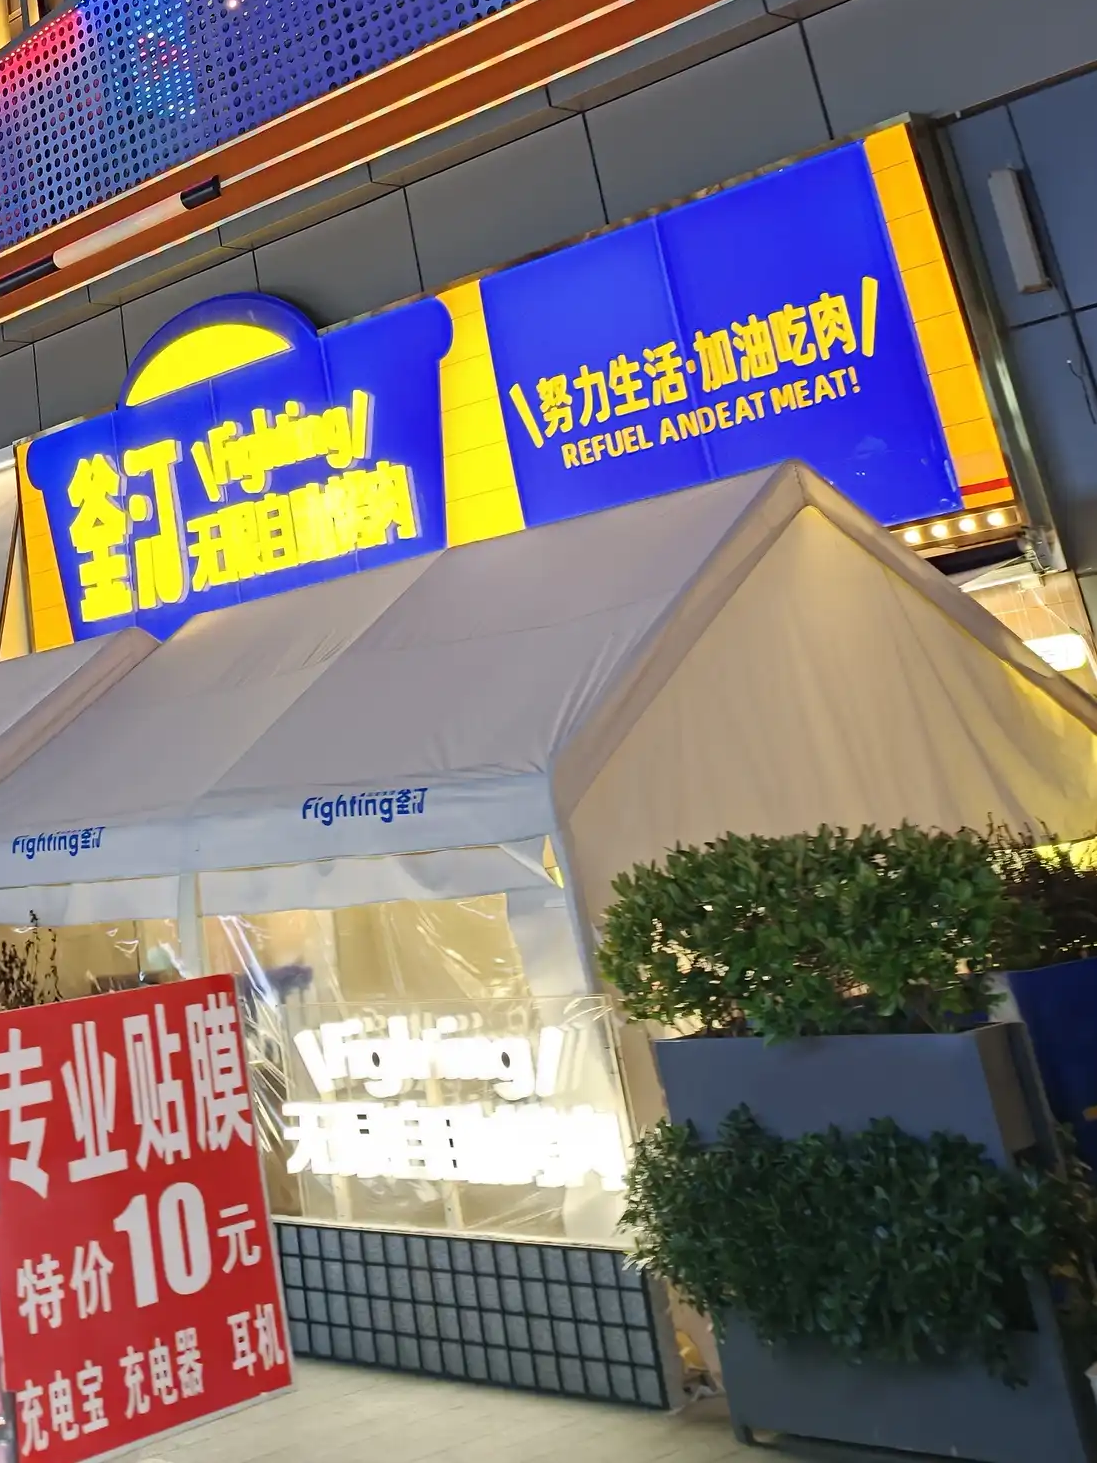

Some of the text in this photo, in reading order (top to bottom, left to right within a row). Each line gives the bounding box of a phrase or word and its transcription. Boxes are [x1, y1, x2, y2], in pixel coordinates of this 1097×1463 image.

[561, 424, 654, 469] REFUEL
[768, 366, 861, 414] MEAT!
[302, 793, 394, 826] Fighting
[12, 831, 79, 859] Fighting
[15, 1302, 284, 1457] 充电宝 充电器 耳机
